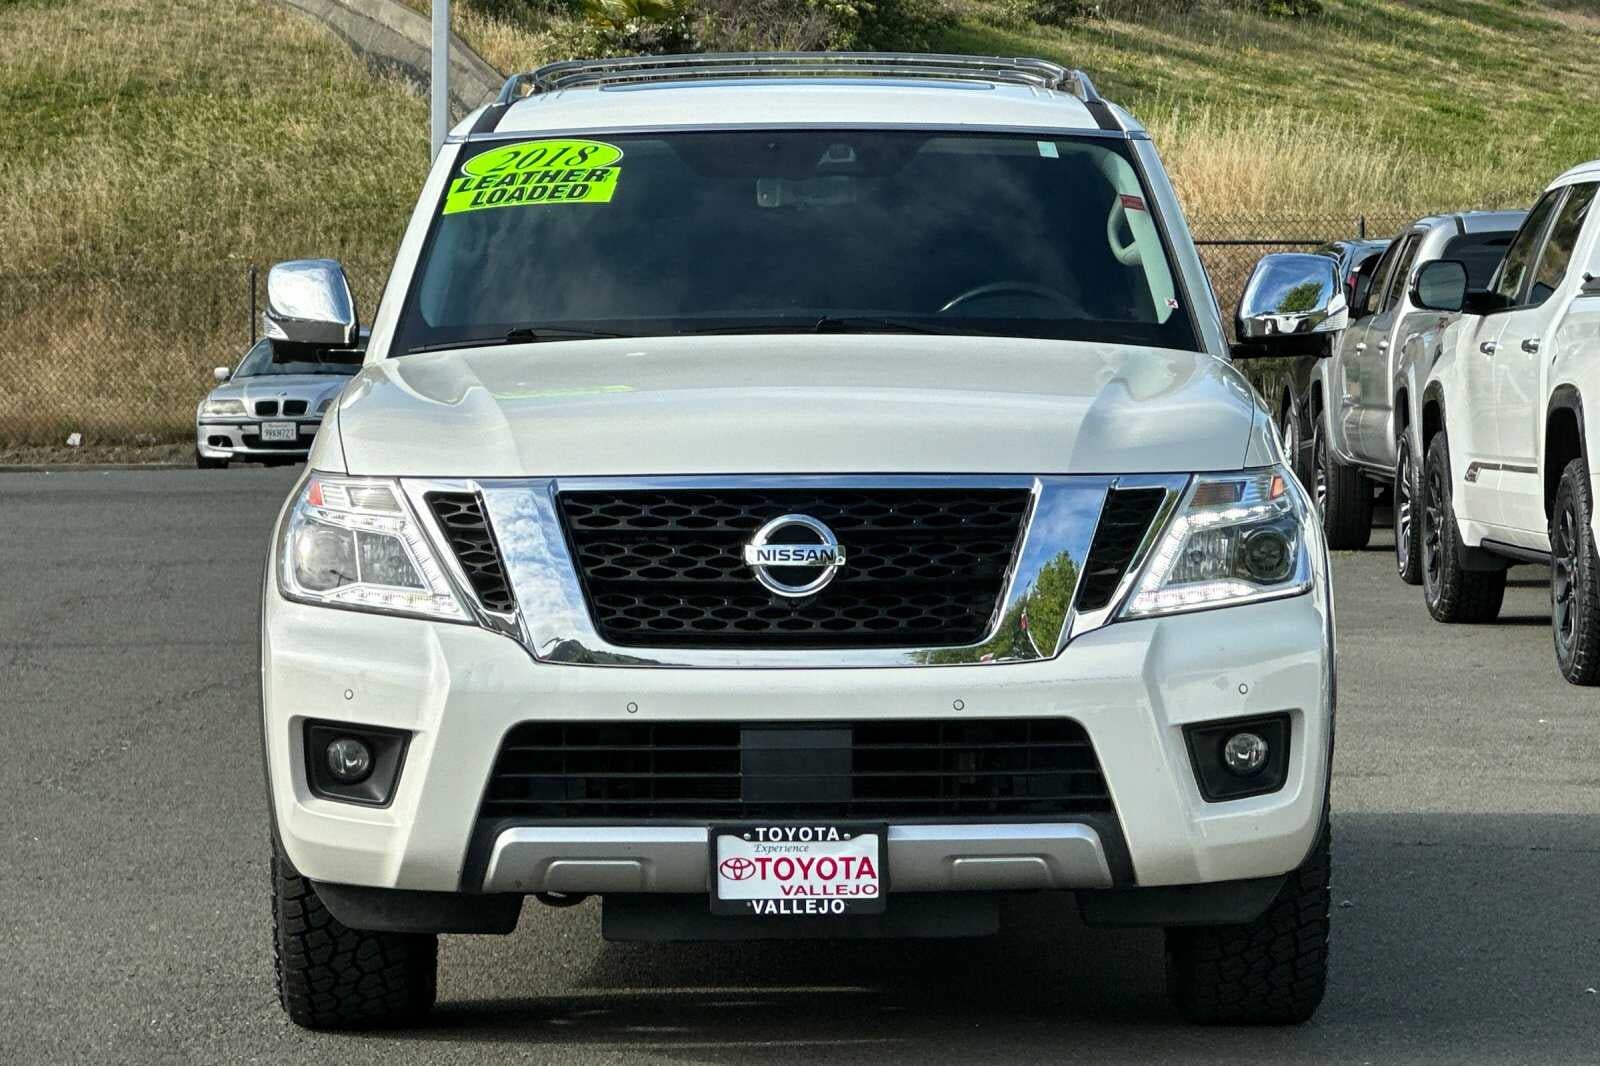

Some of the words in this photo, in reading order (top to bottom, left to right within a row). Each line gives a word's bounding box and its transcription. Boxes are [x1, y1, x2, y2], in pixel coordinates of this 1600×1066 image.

[488, 145, 600, 173] 2018
[454, 168, 612, 193] LEATHER
[469, 183, 592, 208] LOADED
[757, 549, 834, 562] NISSAN
[755, 827, 839, 842] TOYOTA
[754, 844, 809, 854] Experience
[754, 856, 877, 881] TOYOTA
[780, 884, 878, 896] VALLEJO
[751, 899, 845, 915] VALLEJO
